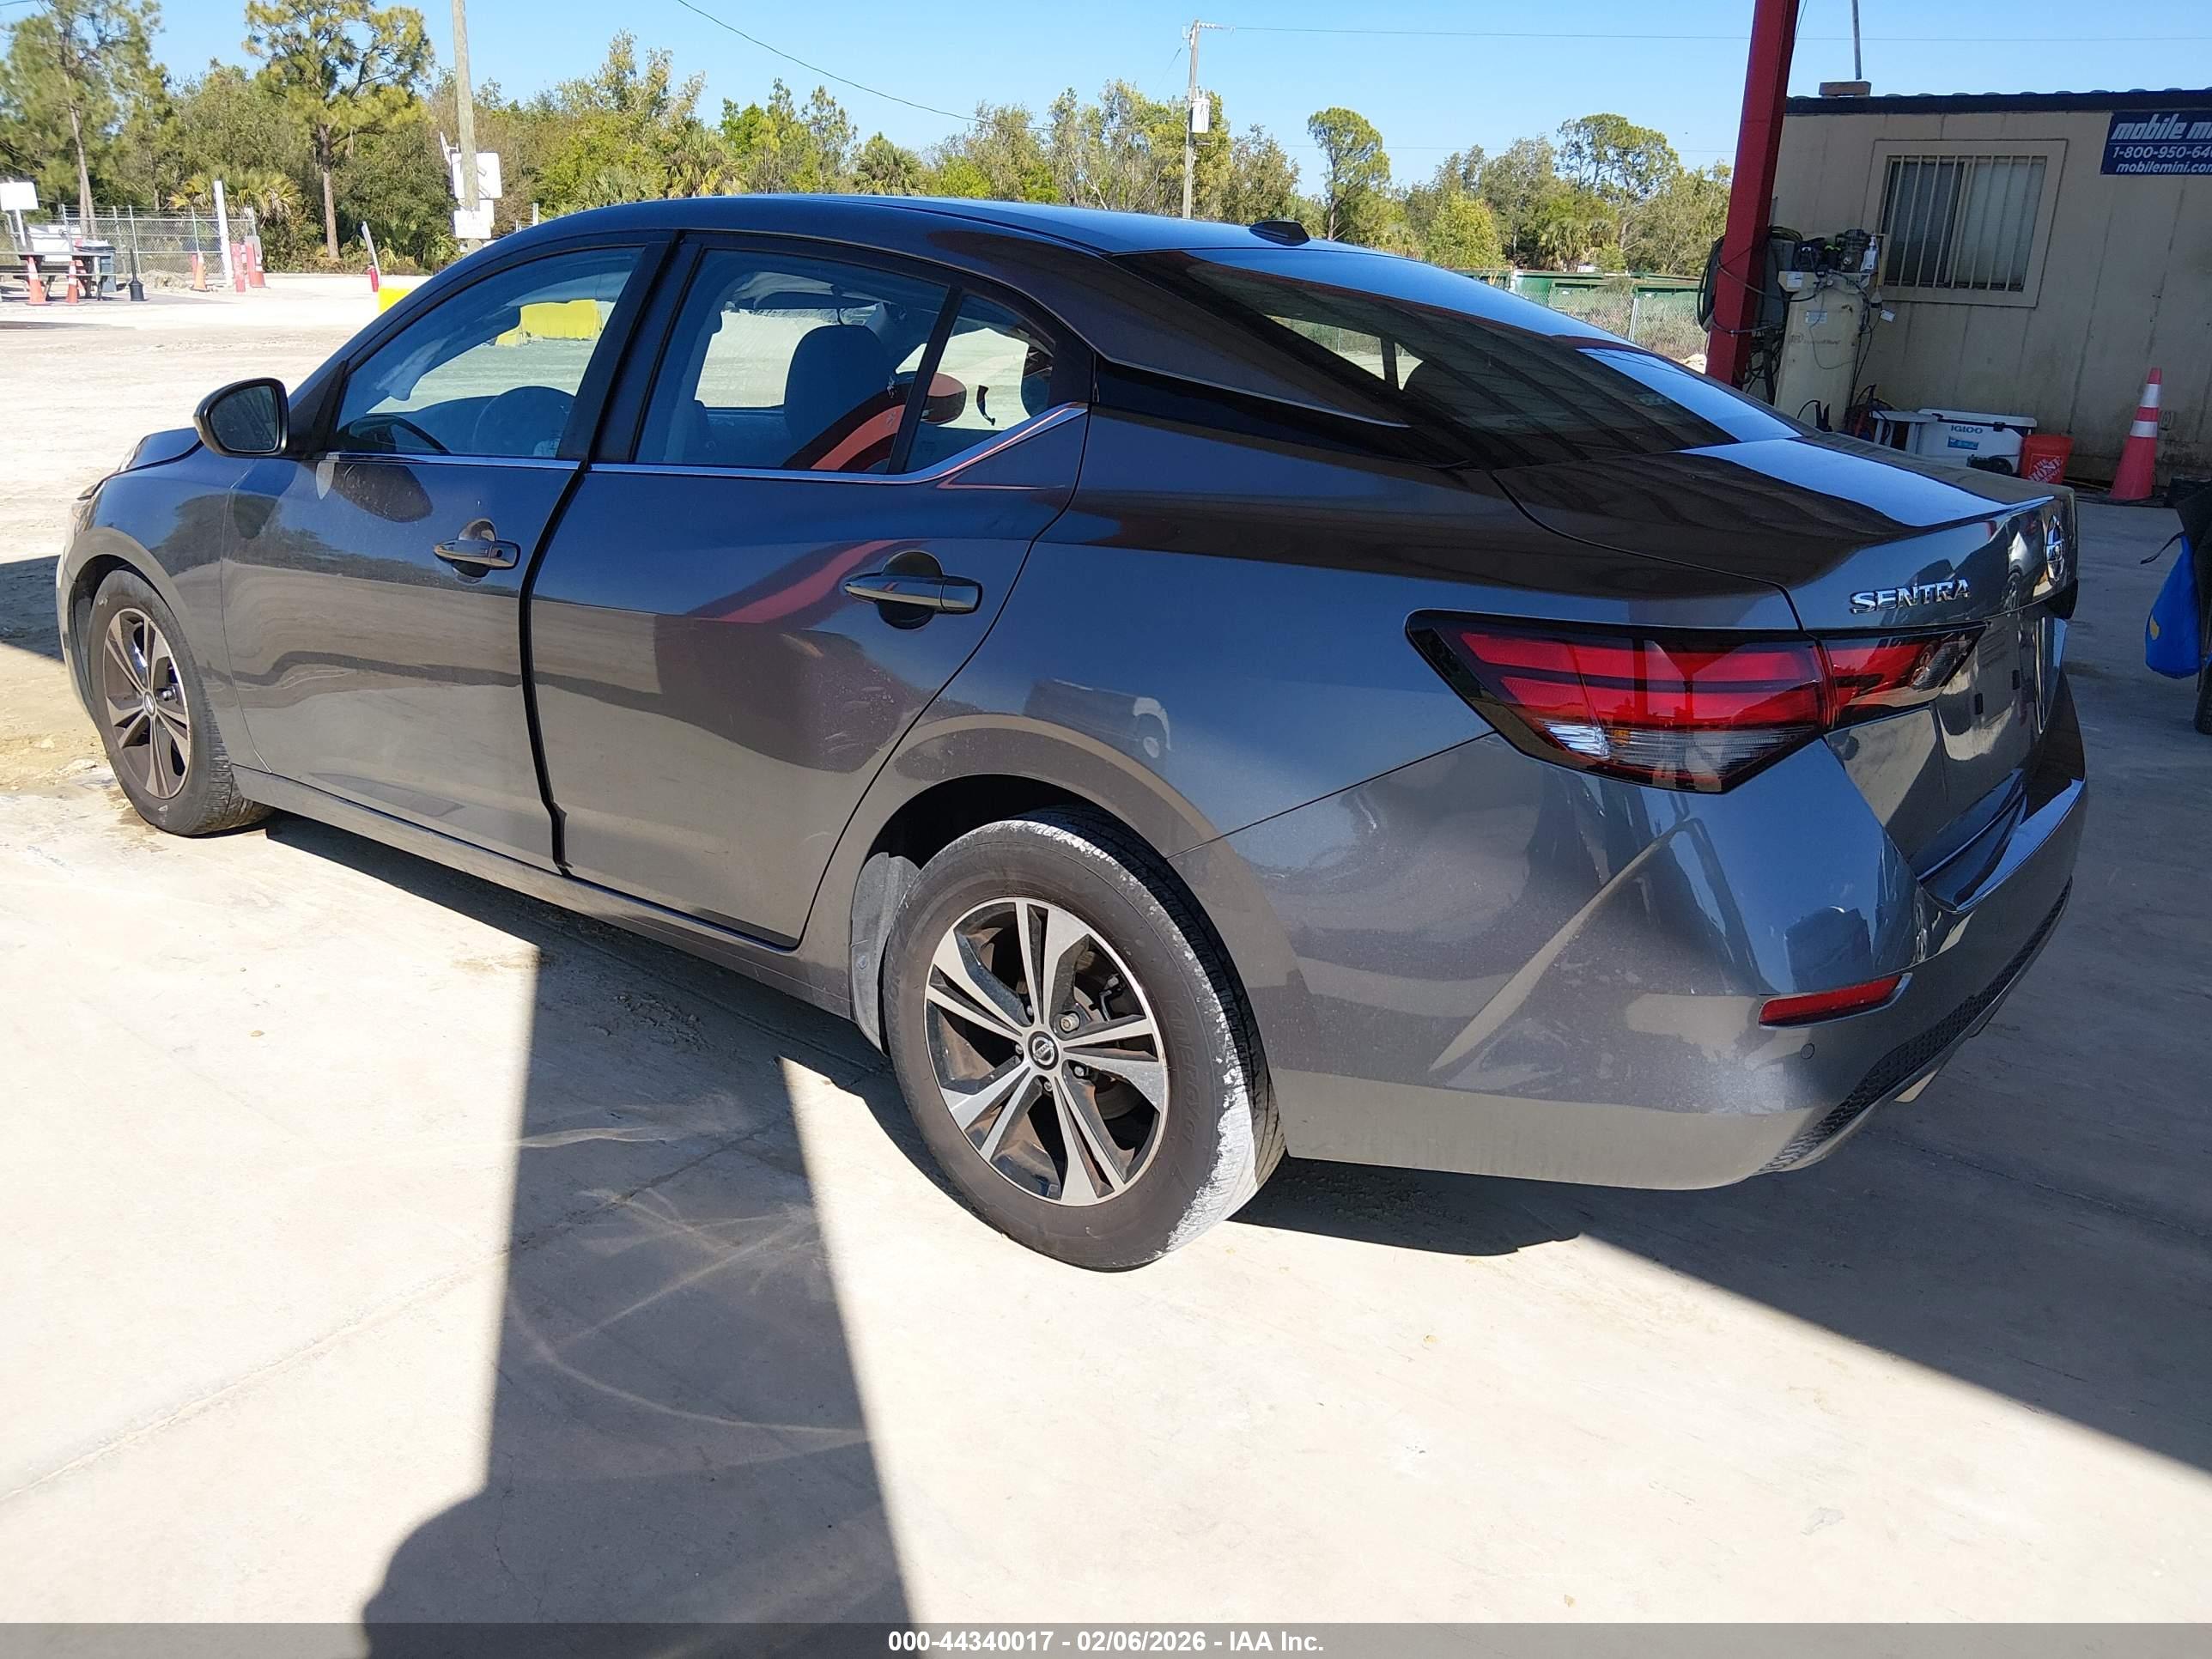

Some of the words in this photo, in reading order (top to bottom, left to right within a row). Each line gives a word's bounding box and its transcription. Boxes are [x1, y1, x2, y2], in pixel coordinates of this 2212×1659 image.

[2111, 113, 2188, 140] mobile
[2112, 146, 2212, 159] 1-800-950-64
[1951, 425, 1984, 434] IGLOO
[1850, 579, 1972, 614] SENTRA
